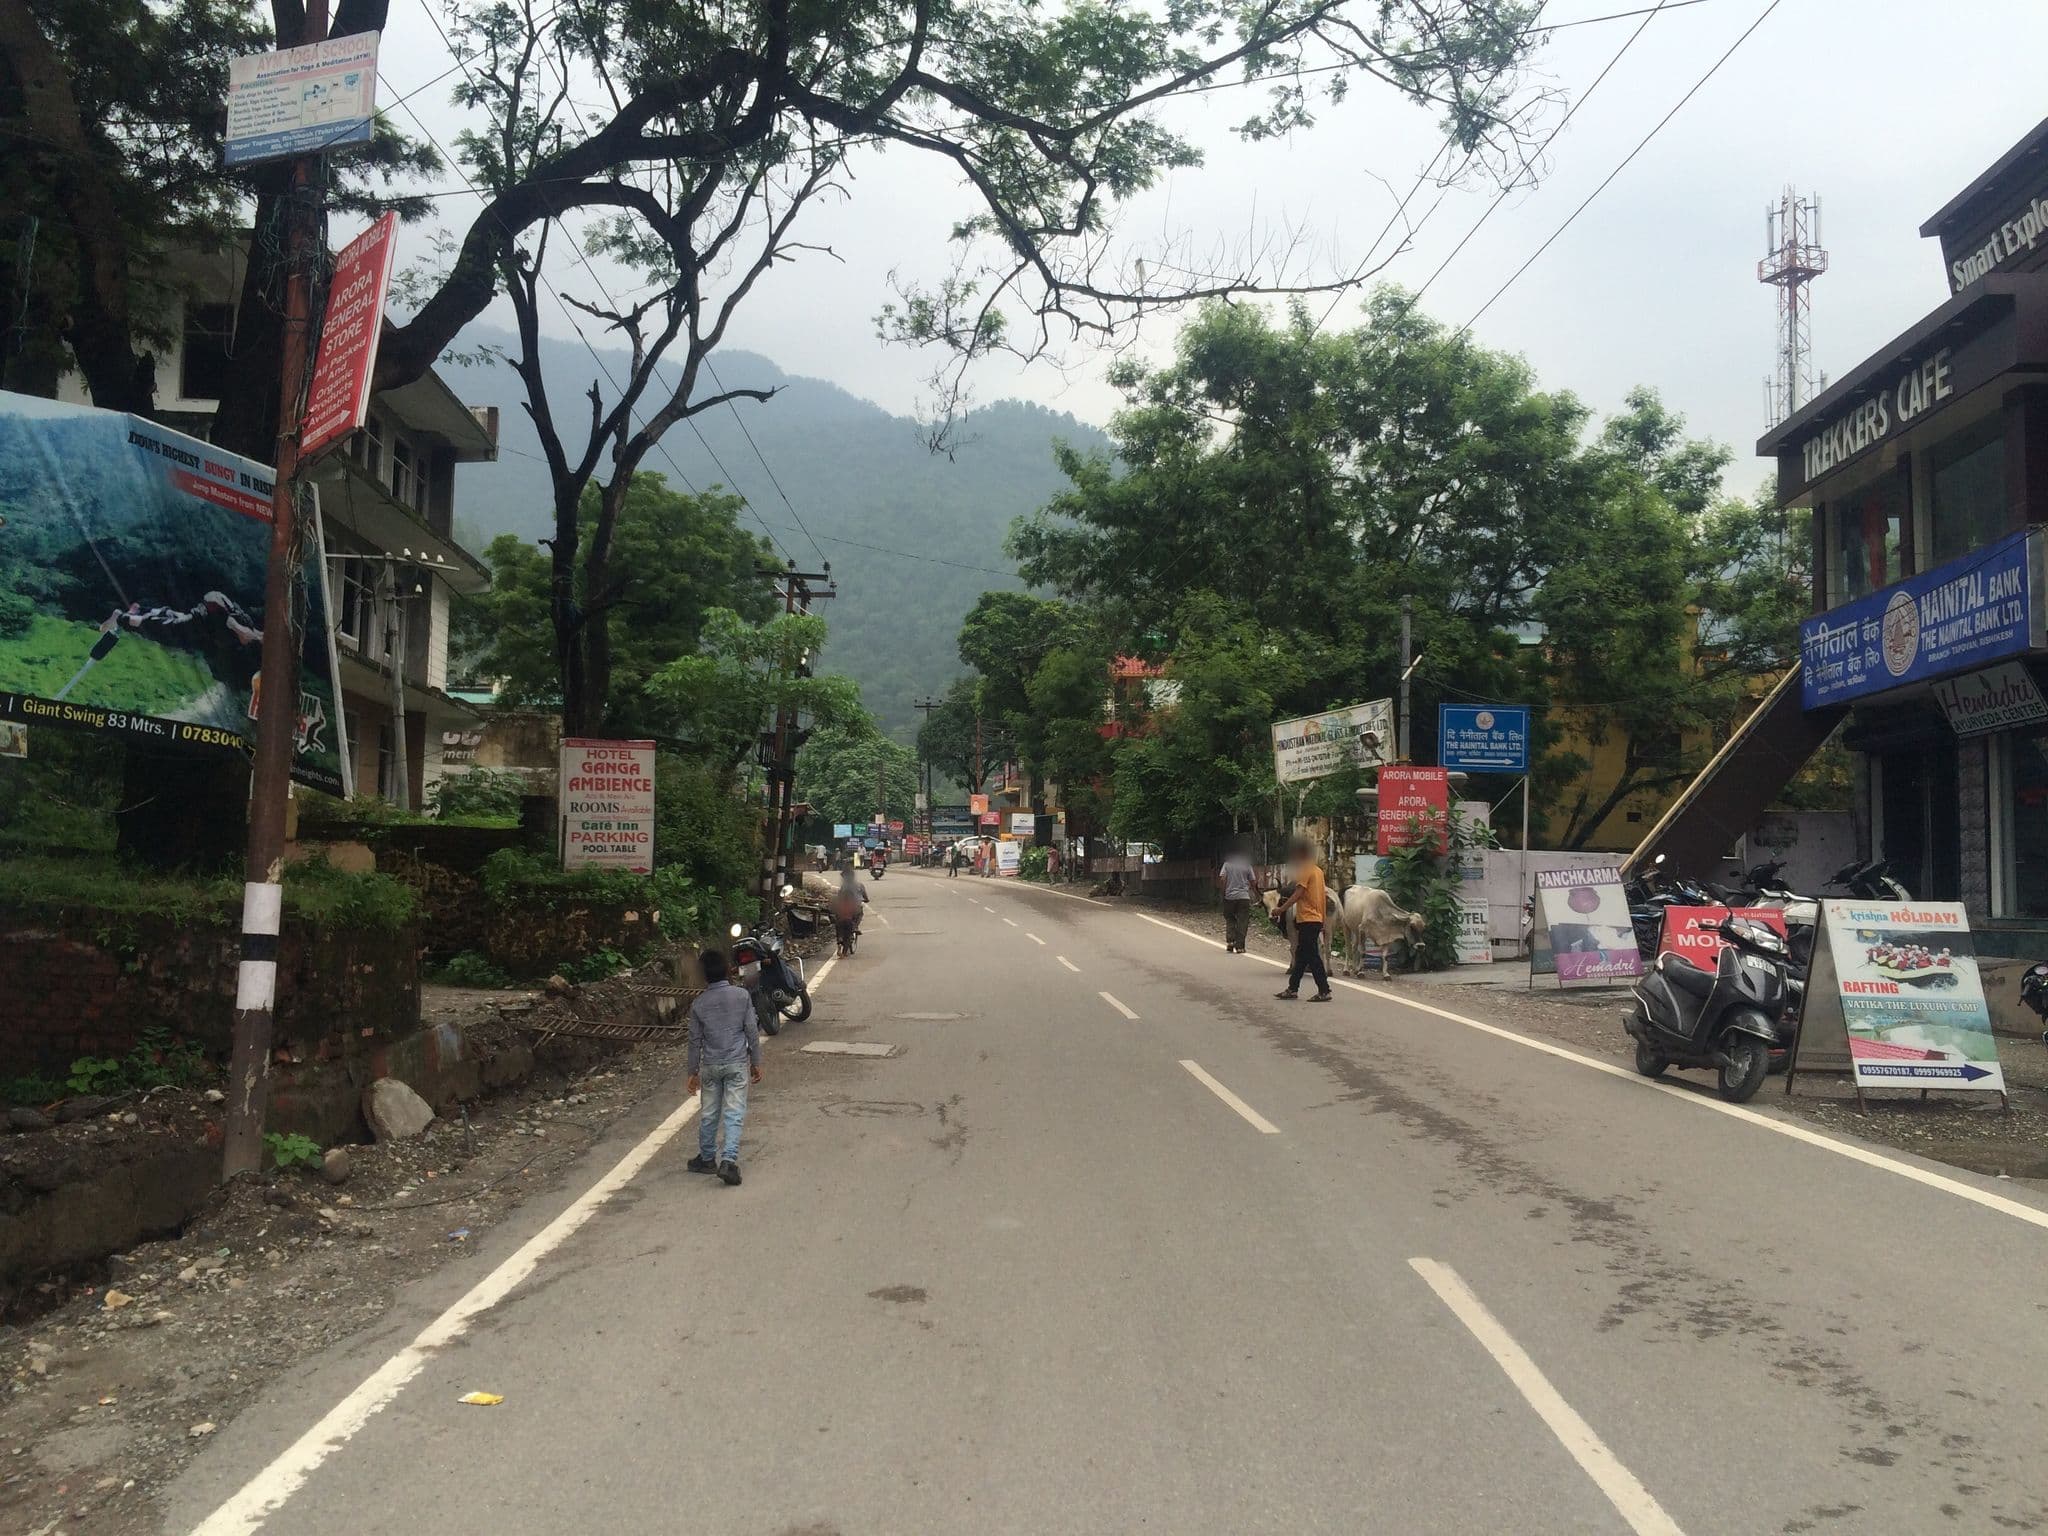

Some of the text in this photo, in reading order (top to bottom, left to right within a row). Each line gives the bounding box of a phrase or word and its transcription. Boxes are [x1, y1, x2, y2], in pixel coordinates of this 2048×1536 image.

[287, 48, 319, 66] YOGA
[323, 37, 370, 60] SCHOOL
[335, 220, 388, 273] ARORA MOBILE
[1953, 197, 2048, 292] Smart Explo
[353, 261, 360, 274] &
[332, 270, 373, 313] ARORA
[322, 290, 375, 338] GENERAL
[325, 316, 364, 357] STORE
[329, 336, 367, 371] Packed
[327, 361, 347, 382] And
[316, 369, 353, 400] Organic
[310, 380, 353, 412] Products
[308, 393, 351, 428] Available
[1802, 349, 1953, 483] TREKKERS CAFE
[162, 443, 200, 469] HIGHEST
[204, 460, 235, 483] BUNGY
[240, 472, 251, 487] IN
[252, 478, 273, 497] RISH
[210, 487, 238, 504] Masters
[1920, 566, 2022, 628] NAINITAL BANK
[1920, 600, 2024, 652] THE NAINITAL BANK LTD.
[1803, 621, 1858, 662] नैनीताल
[23, 699, 60, 718] Giant
[63, 705, 105, 728] Swing
[107, 713, 127, 728] 83
[130, 717, 165, 735] Mtrs.
[1953, 701, 2045, 732] AYURVEDA CENTRE
[443, 748, 476, 760] ment
[586, 749, 636, 761] HOTEL
[1446, 741, 1522, 751] THE NAINITAL BANK LTD.
[581, 761, 641, 775] GANGA
[1382, 770, 1444, 781] ARORA MOBILE
[568, 777, 652, 793] AMBIENCE
[570, 801, 620, 814] ROOMS
[1398, 796, 1427, 807] ARORA
[1379, 809, 1415, 821] GENERAL
[570, 832, 649, 843] PARKING
[582, 844, 637, 853] POOL TABLE
[1537, 867, 1621, 888] PANCHKARMA
[1457, 912, 1487, 925] OTEL
[1890, 908, 1959, 925] HOLIDAYS
[1843, 981, 1900, 994] RAFTING
[1847, 1000, 1979, 1012] VATIKA THE LUXURY CAMP
